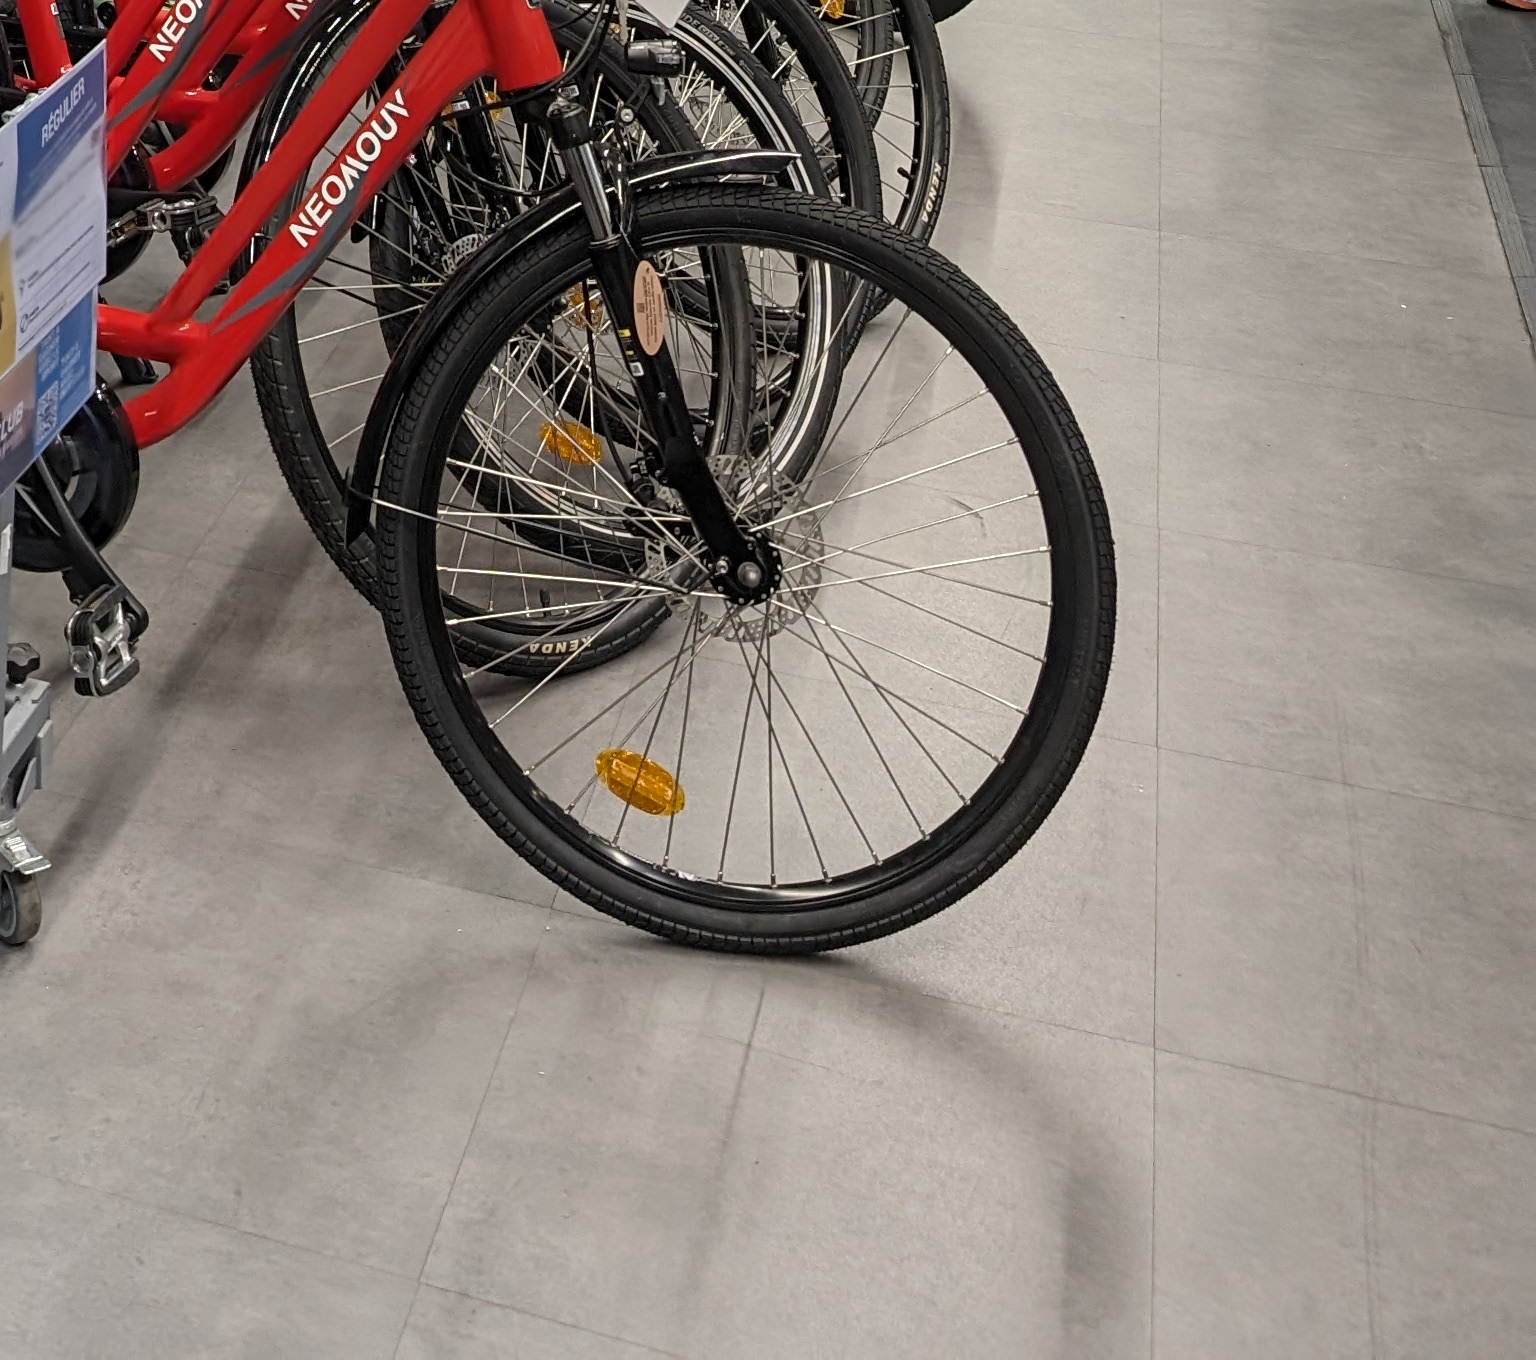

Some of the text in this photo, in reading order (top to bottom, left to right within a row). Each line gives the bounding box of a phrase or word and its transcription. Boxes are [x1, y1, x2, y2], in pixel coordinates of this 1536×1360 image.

[41, 77, 86, 148] RÉGULIER
[289, 88, 412, 249] NEOMOUV
[921, 161, 942, 223] KENDA
[529, 635, 592, 654] KENDA
